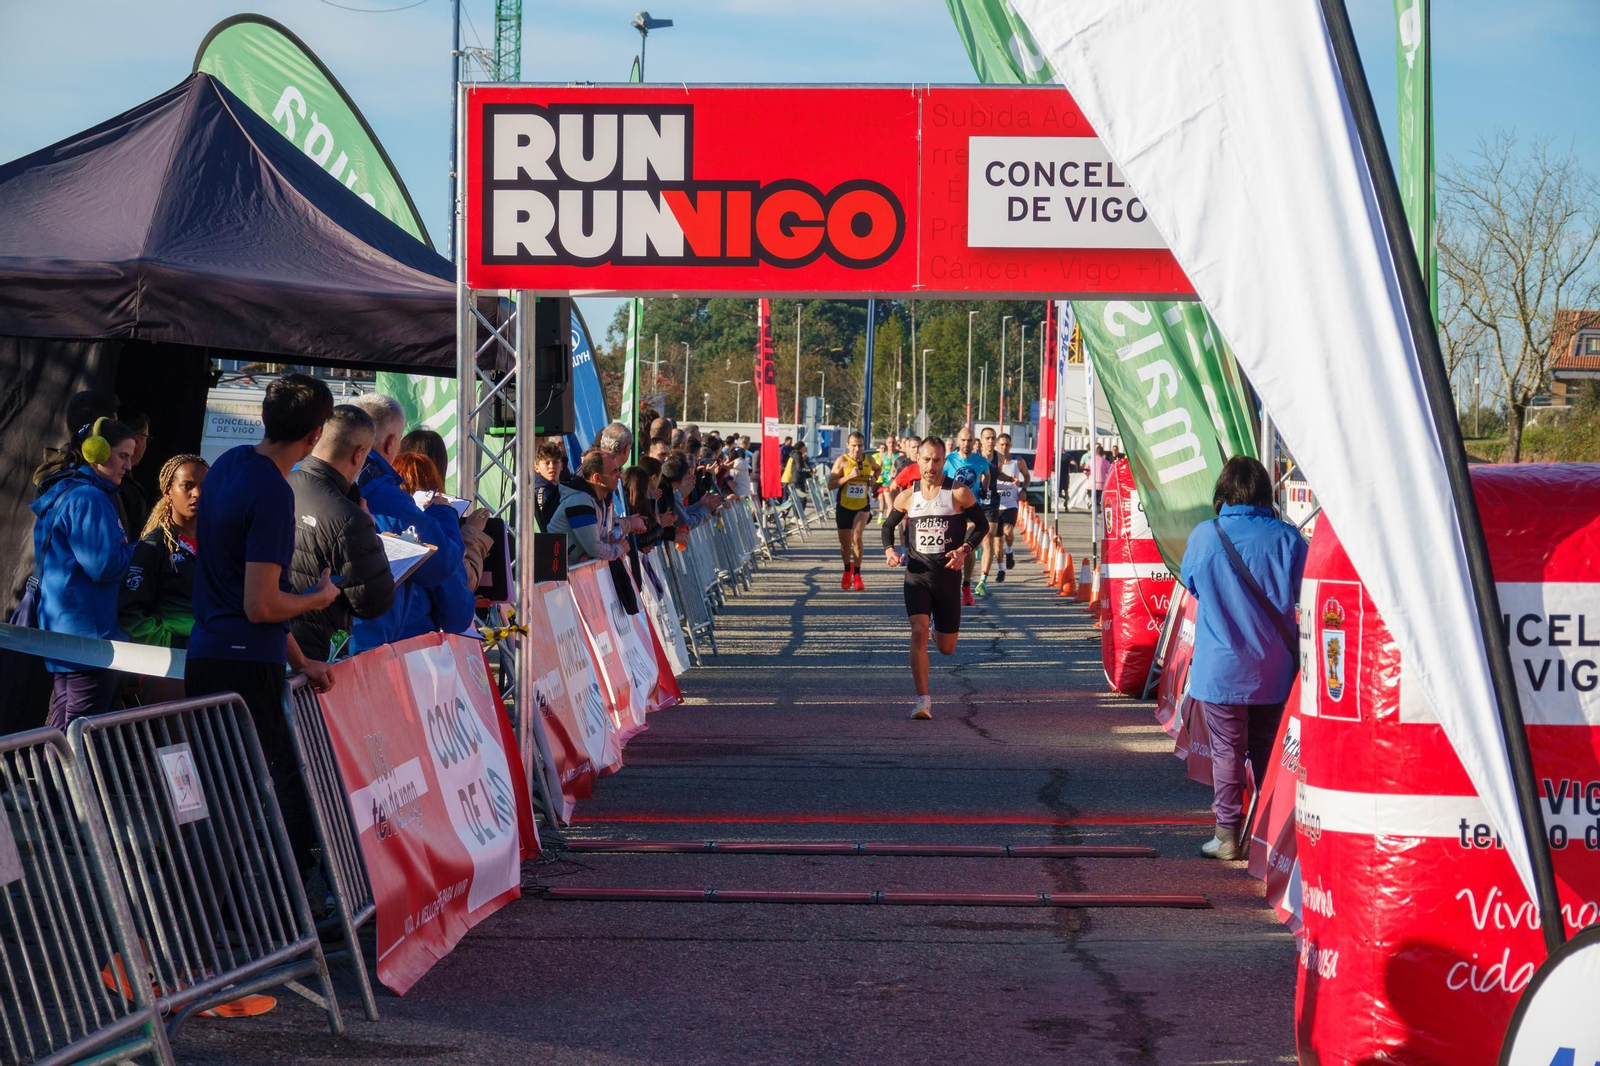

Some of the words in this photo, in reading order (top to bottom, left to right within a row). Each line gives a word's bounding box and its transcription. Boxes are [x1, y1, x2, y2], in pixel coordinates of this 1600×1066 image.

[932, 104, 1031, 128] Subida
[1042, 104, 1078, 129] Ao
[493, 114, 686, 182] RUN
[985, 161, 1134, 187] CONCEL
[1007, 197, 1051, 222] DE
[1065, 197, 1148, 223] VIGO
[930, 256, 1032, 280] Cáncer
[1059, 257, 1121, 286] Vigo
[211, 417, 262, 427] CONCELLO
[216, 425, 229, 433] DE
[849, 486, 864, 494] 236
[920, 535, 944, 546] 226
[1523, 659, 1599, 692] VIG
